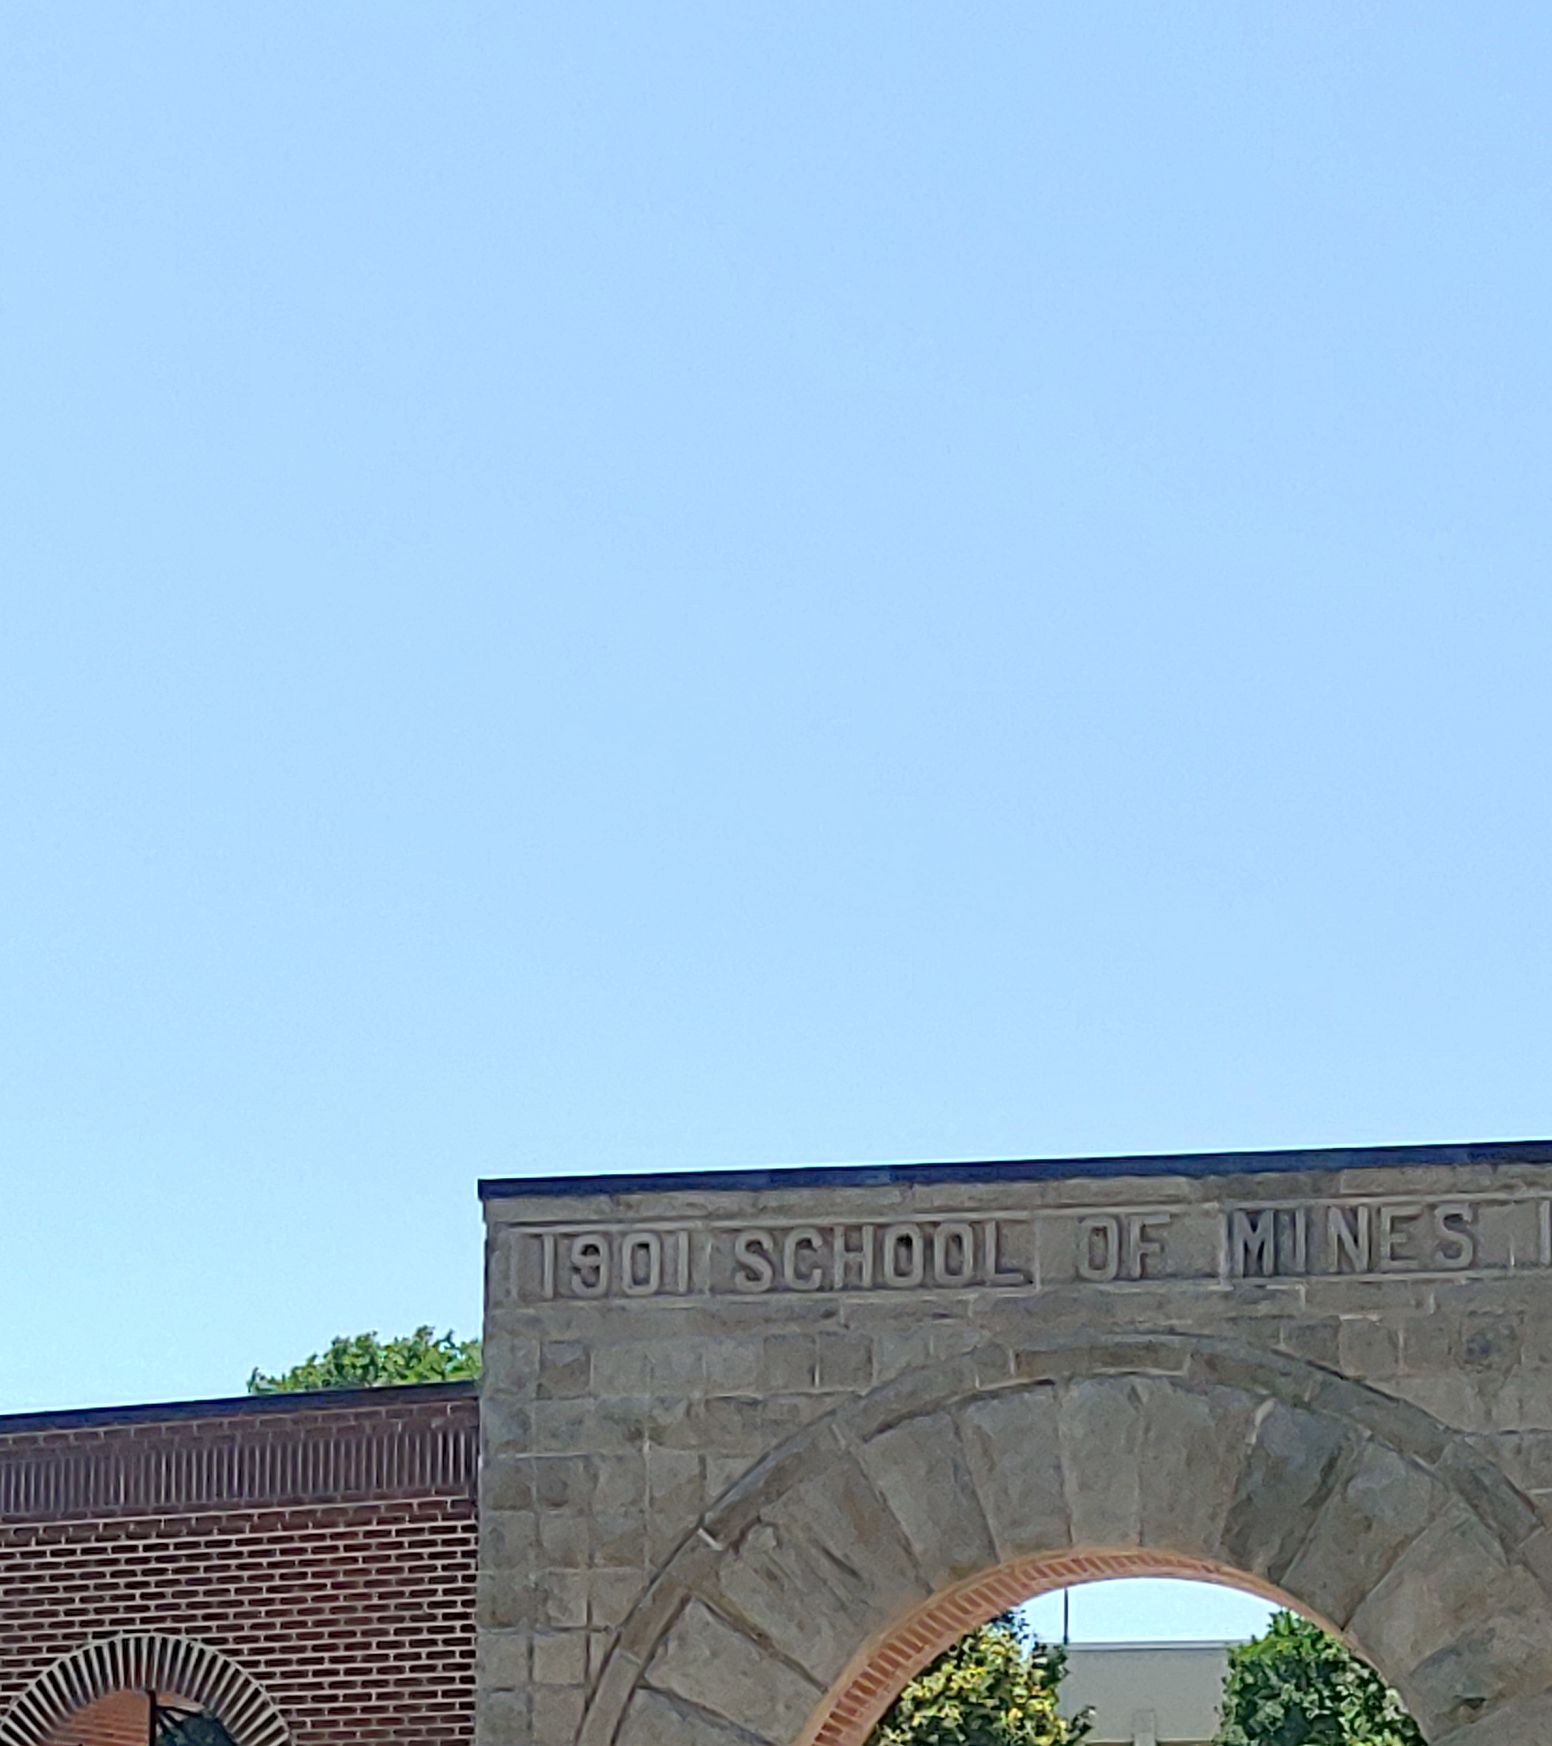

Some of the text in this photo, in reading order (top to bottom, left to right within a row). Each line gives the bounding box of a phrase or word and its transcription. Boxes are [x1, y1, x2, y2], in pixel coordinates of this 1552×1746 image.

[543, 1230, 688, 1299] 1901
[735, 1221, 1024, 1294] SCHOOL
[1078, 1213, 1172, 1281] OF
[1233, 1203, 1474, 1276] MINES
